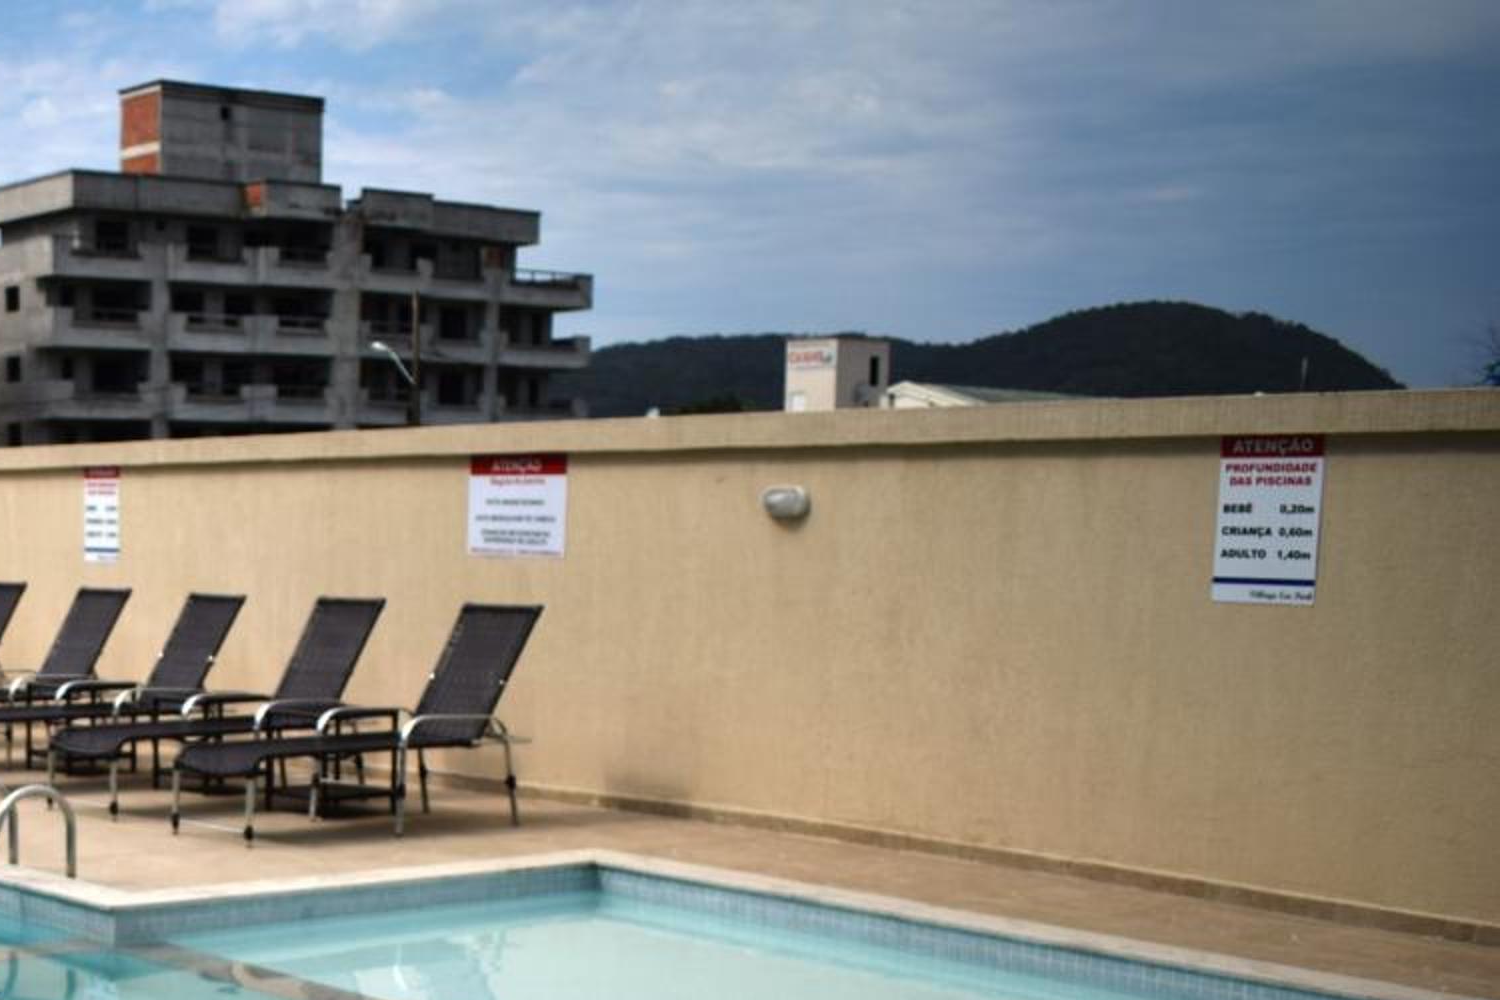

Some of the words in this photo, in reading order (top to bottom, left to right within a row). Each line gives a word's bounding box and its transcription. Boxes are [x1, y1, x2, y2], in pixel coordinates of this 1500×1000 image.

[1232, 436, 1315, 453] ATENÇÃO
[1225, 462, 1317, 473] PROFUNDIDADE
[1229, 475, 1252, 486] DAS
[1255, 475, 1313, 487] PISCINAS
[1223, 502, 1252, 514] BEBÊ
[1221, 525, 1273, 538] CRIANÇA
[1278, 526, 1313, 538] 0,60m
[1220, 548, 1268, 559] ADULTO
[1277, 549, 1312, 560] 1,40m
